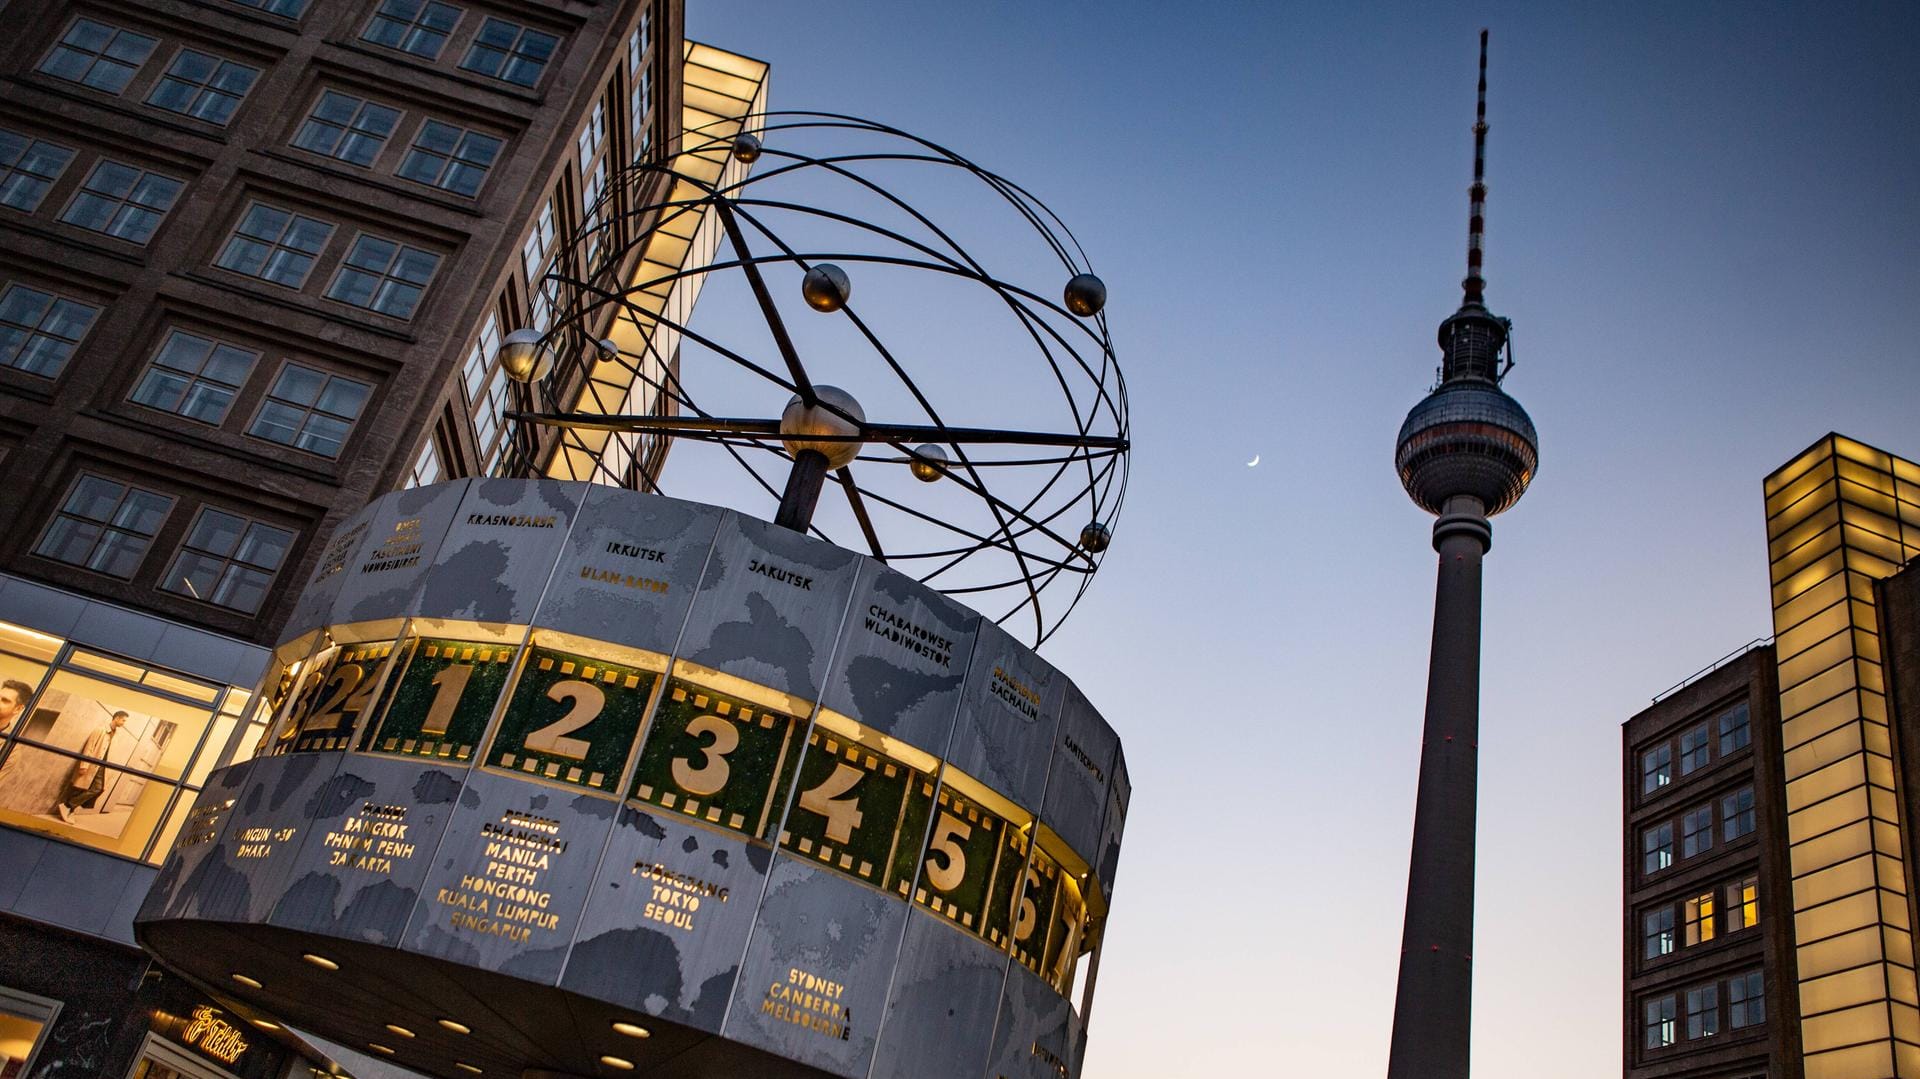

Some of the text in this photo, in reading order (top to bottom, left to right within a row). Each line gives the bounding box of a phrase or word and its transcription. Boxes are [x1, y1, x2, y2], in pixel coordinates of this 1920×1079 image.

[605, 542, 667, 563] IRKUTSK
[580, 565, 670, 595] ULAN-BATOR
[748, 559, 814, 592] JAKUTSK
[864, 616, 951, 669] WLADIWOSTOK
[869, 604, 954, 653] CHABAROWSK
[420, 664, 475, 735] 1
[989, 679, 1039, 722] SACHALIN
[524, 680, 606, 761] 2
[671, 715, 740, 796] 3
[360, 802, 408, 821] HANOI
[798, 763, 866, 845] 4
[344, 817, 409, 839] BANGKOK
[480, 822, 569, 854] SHANGHAI
[500, 808, 561, 835] PEKING
[236, 844, 272, 857] DHAKA
[324, 832, 416, 859] PHNOM PENH
[329, 851, 392, 873] JAKARTA
[484, 842, 549, 870] MANILA
[925, 811, 972, 892] 5
[486, 861, 538, 886] PERTH
[460, 875, 551, 909] HONGKONG
[652, 884, 700, 912] TOKYO
[1009, 867, 1041, 941] 6
[437, 888, 560, 931] KUALA LUMPUR
[643, 902, 694, 931] SEOUL
[450, 911, 532, 943] SINGAPUR
[788, 967, 844, 1000] SYDNEY
[770, 982, 850, 1023] CANBERRA
[761, 999, 851, 1041] MELBOURNE
